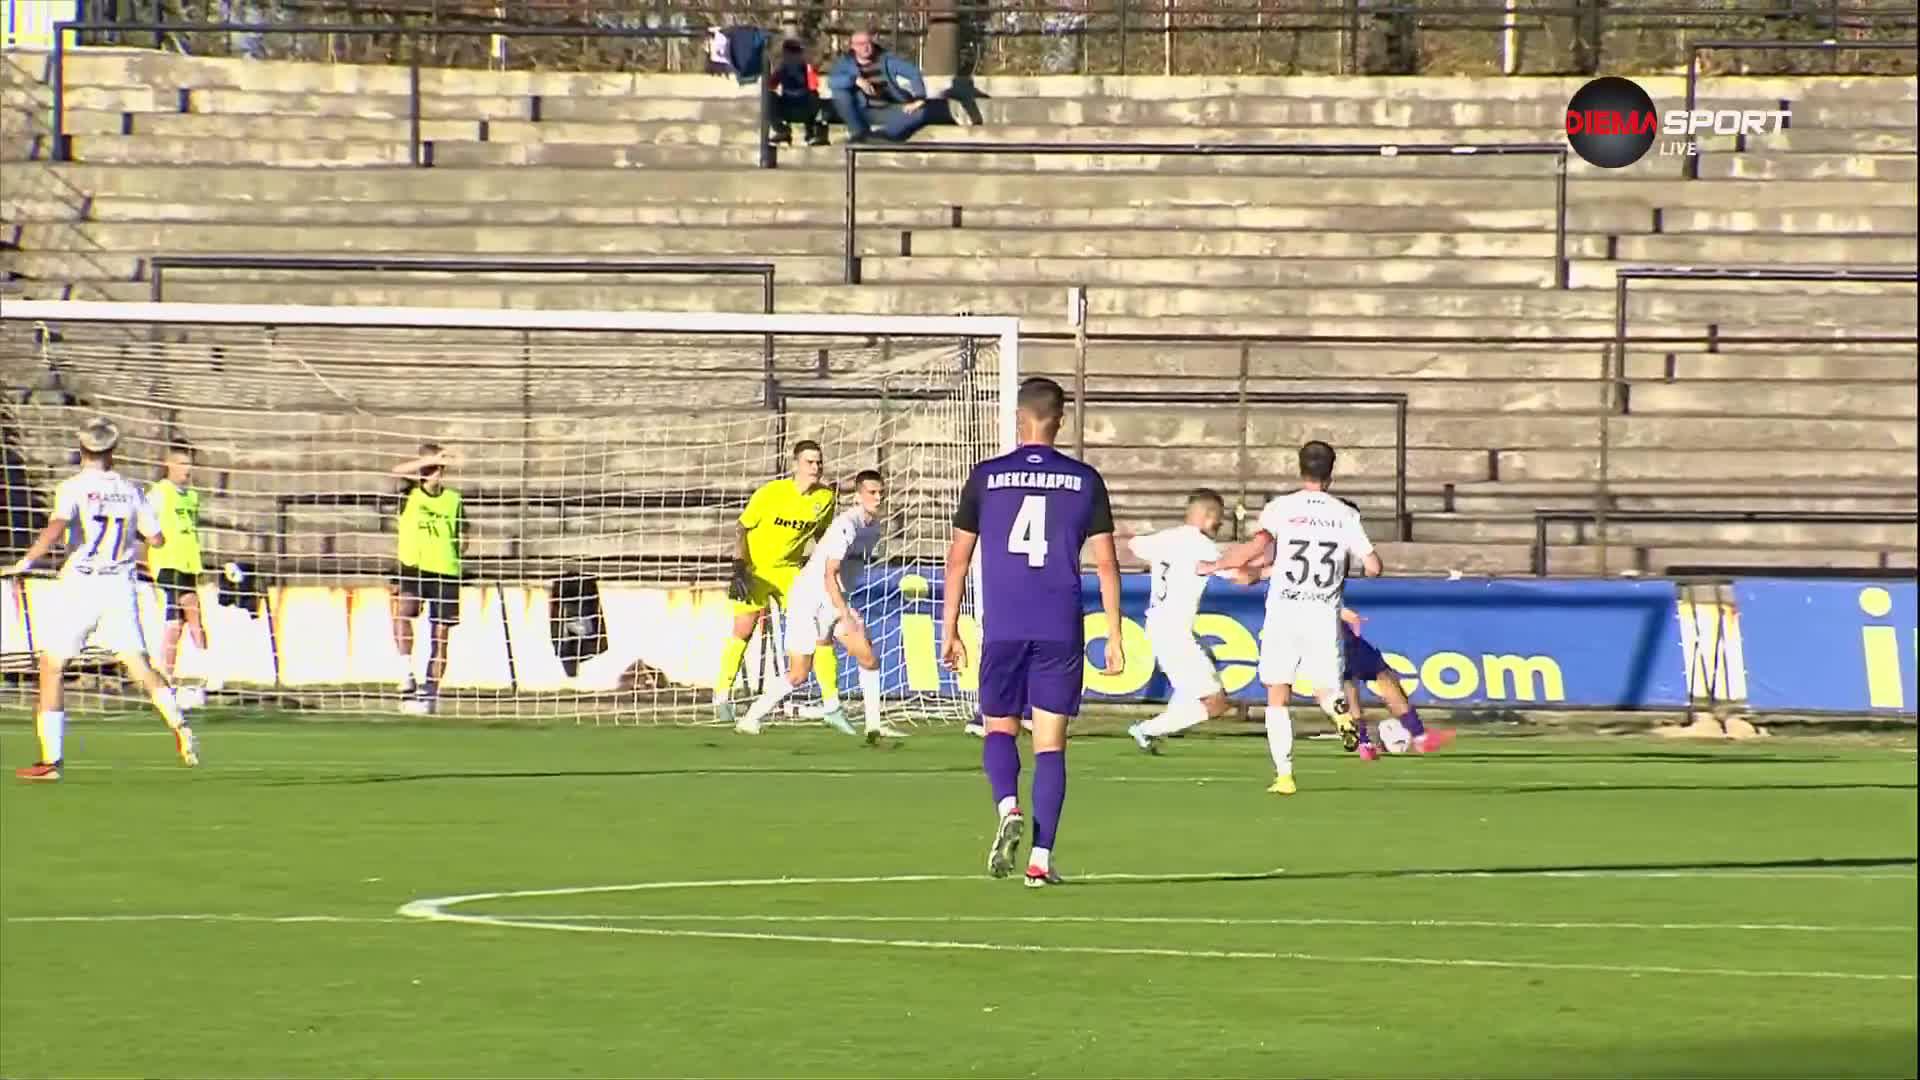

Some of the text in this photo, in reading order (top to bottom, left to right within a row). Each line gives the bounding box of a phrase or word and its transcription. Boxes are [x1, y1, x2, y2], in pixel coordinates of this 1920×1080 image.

[88, 515, 126, 561] 71
[1007, 495, 1048, 568] 4
[1157, 561, 1171, 601] 3
[1285, 539, 1339, 588] 33
